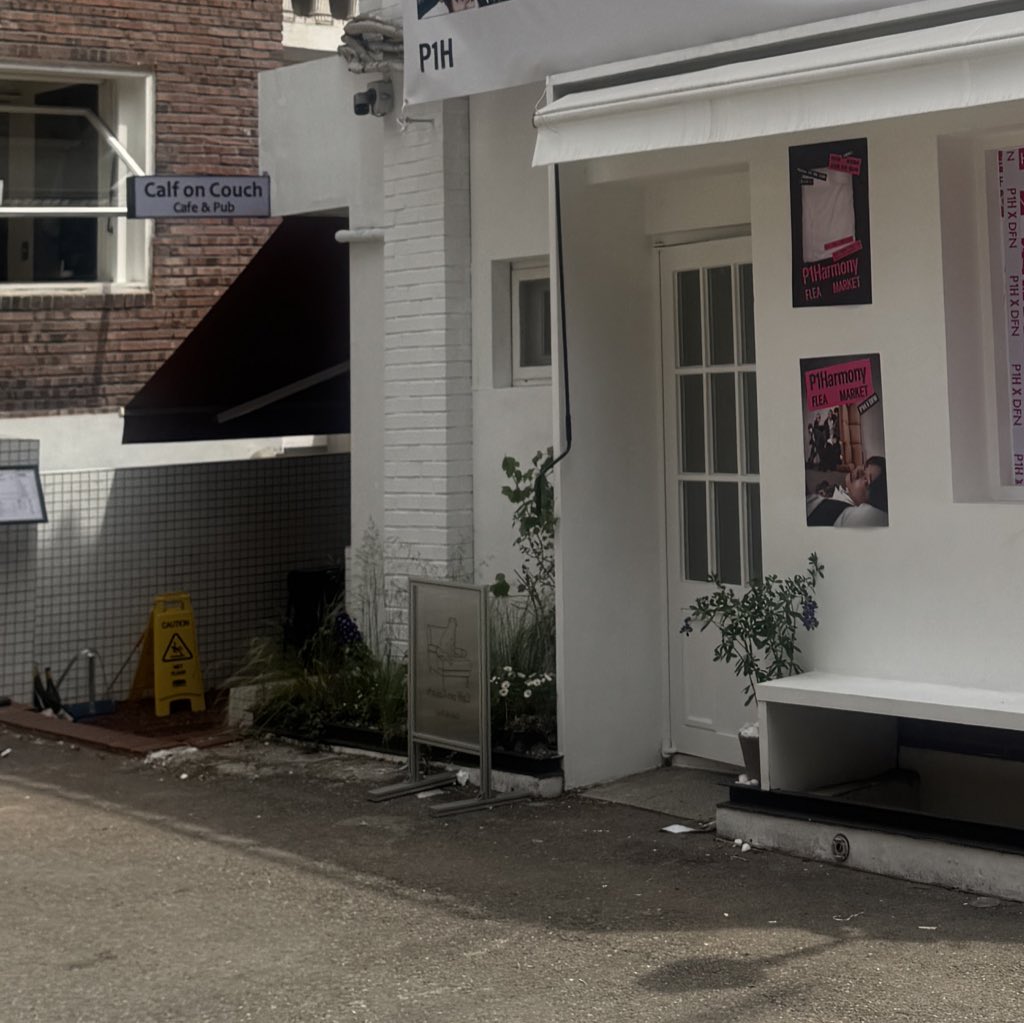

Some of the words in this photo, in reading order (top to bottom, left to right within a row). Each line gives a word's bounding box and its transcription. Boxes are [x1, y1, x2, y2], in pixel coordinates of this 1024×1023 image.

[418, 37, 454, 73] P1H
[144, 180, 180, 198] Calf
[183, 184, 205, 197] on
[209, 181, 263, 198] Couch
[173, 201, 199, 214] Cafe
[201, 202, 210, 214] &
[213, 201, 235, 213] Pub
[802, 258, 859, 285] P1Harmony
[805, 287, 822, 301] FLEA
[832, 276, 861, 294] MARKET
[809, 366, 866, 391] P1Harmony
[811, 393, 828, 407] FLEA
[839, 385, 868, 402] MARKET
